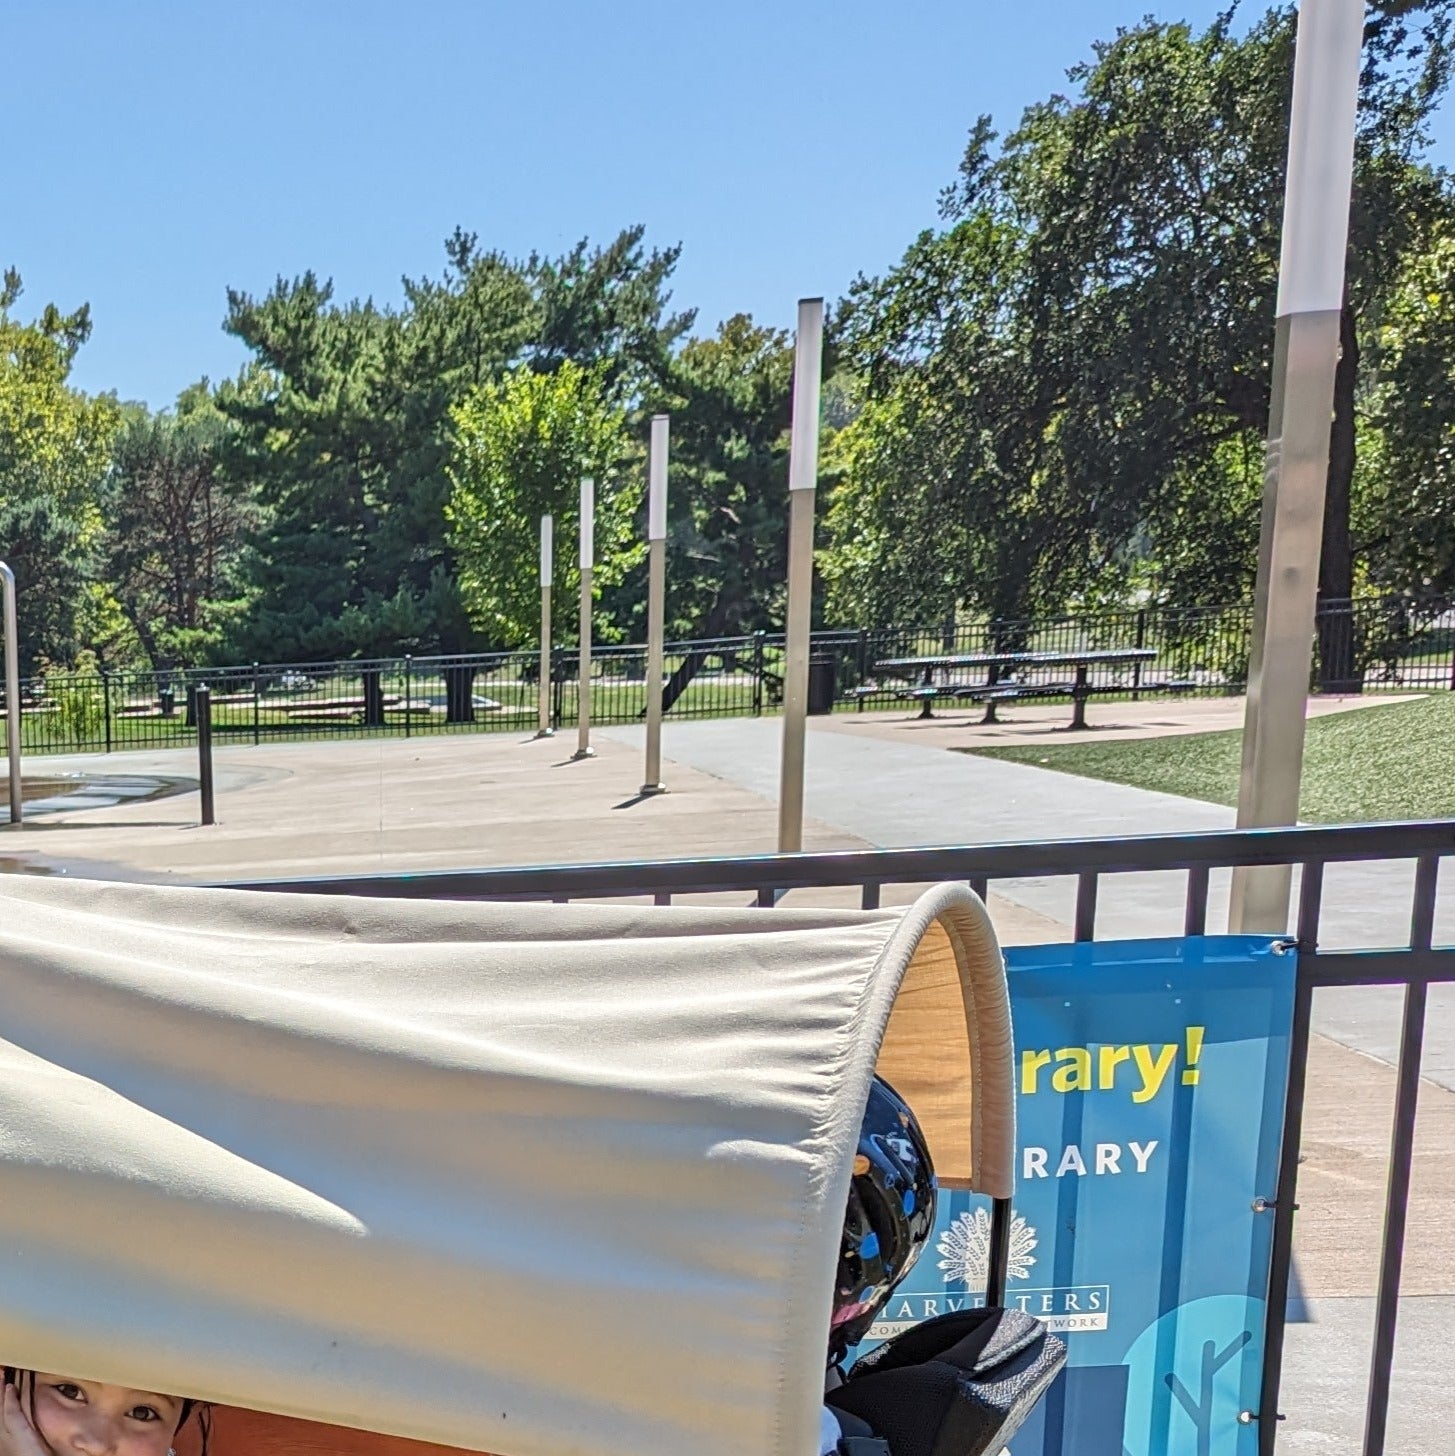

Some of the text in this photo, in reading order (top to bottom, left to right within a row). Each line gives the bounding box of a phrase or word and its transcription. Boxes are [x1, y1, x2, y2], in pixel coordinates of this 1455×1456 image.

[1022, 1140, 1160, 1179] RARY
[880, 1291, 1101, 1319] ARVETERS
[1052, 1317, 1100, 1328] WORK
